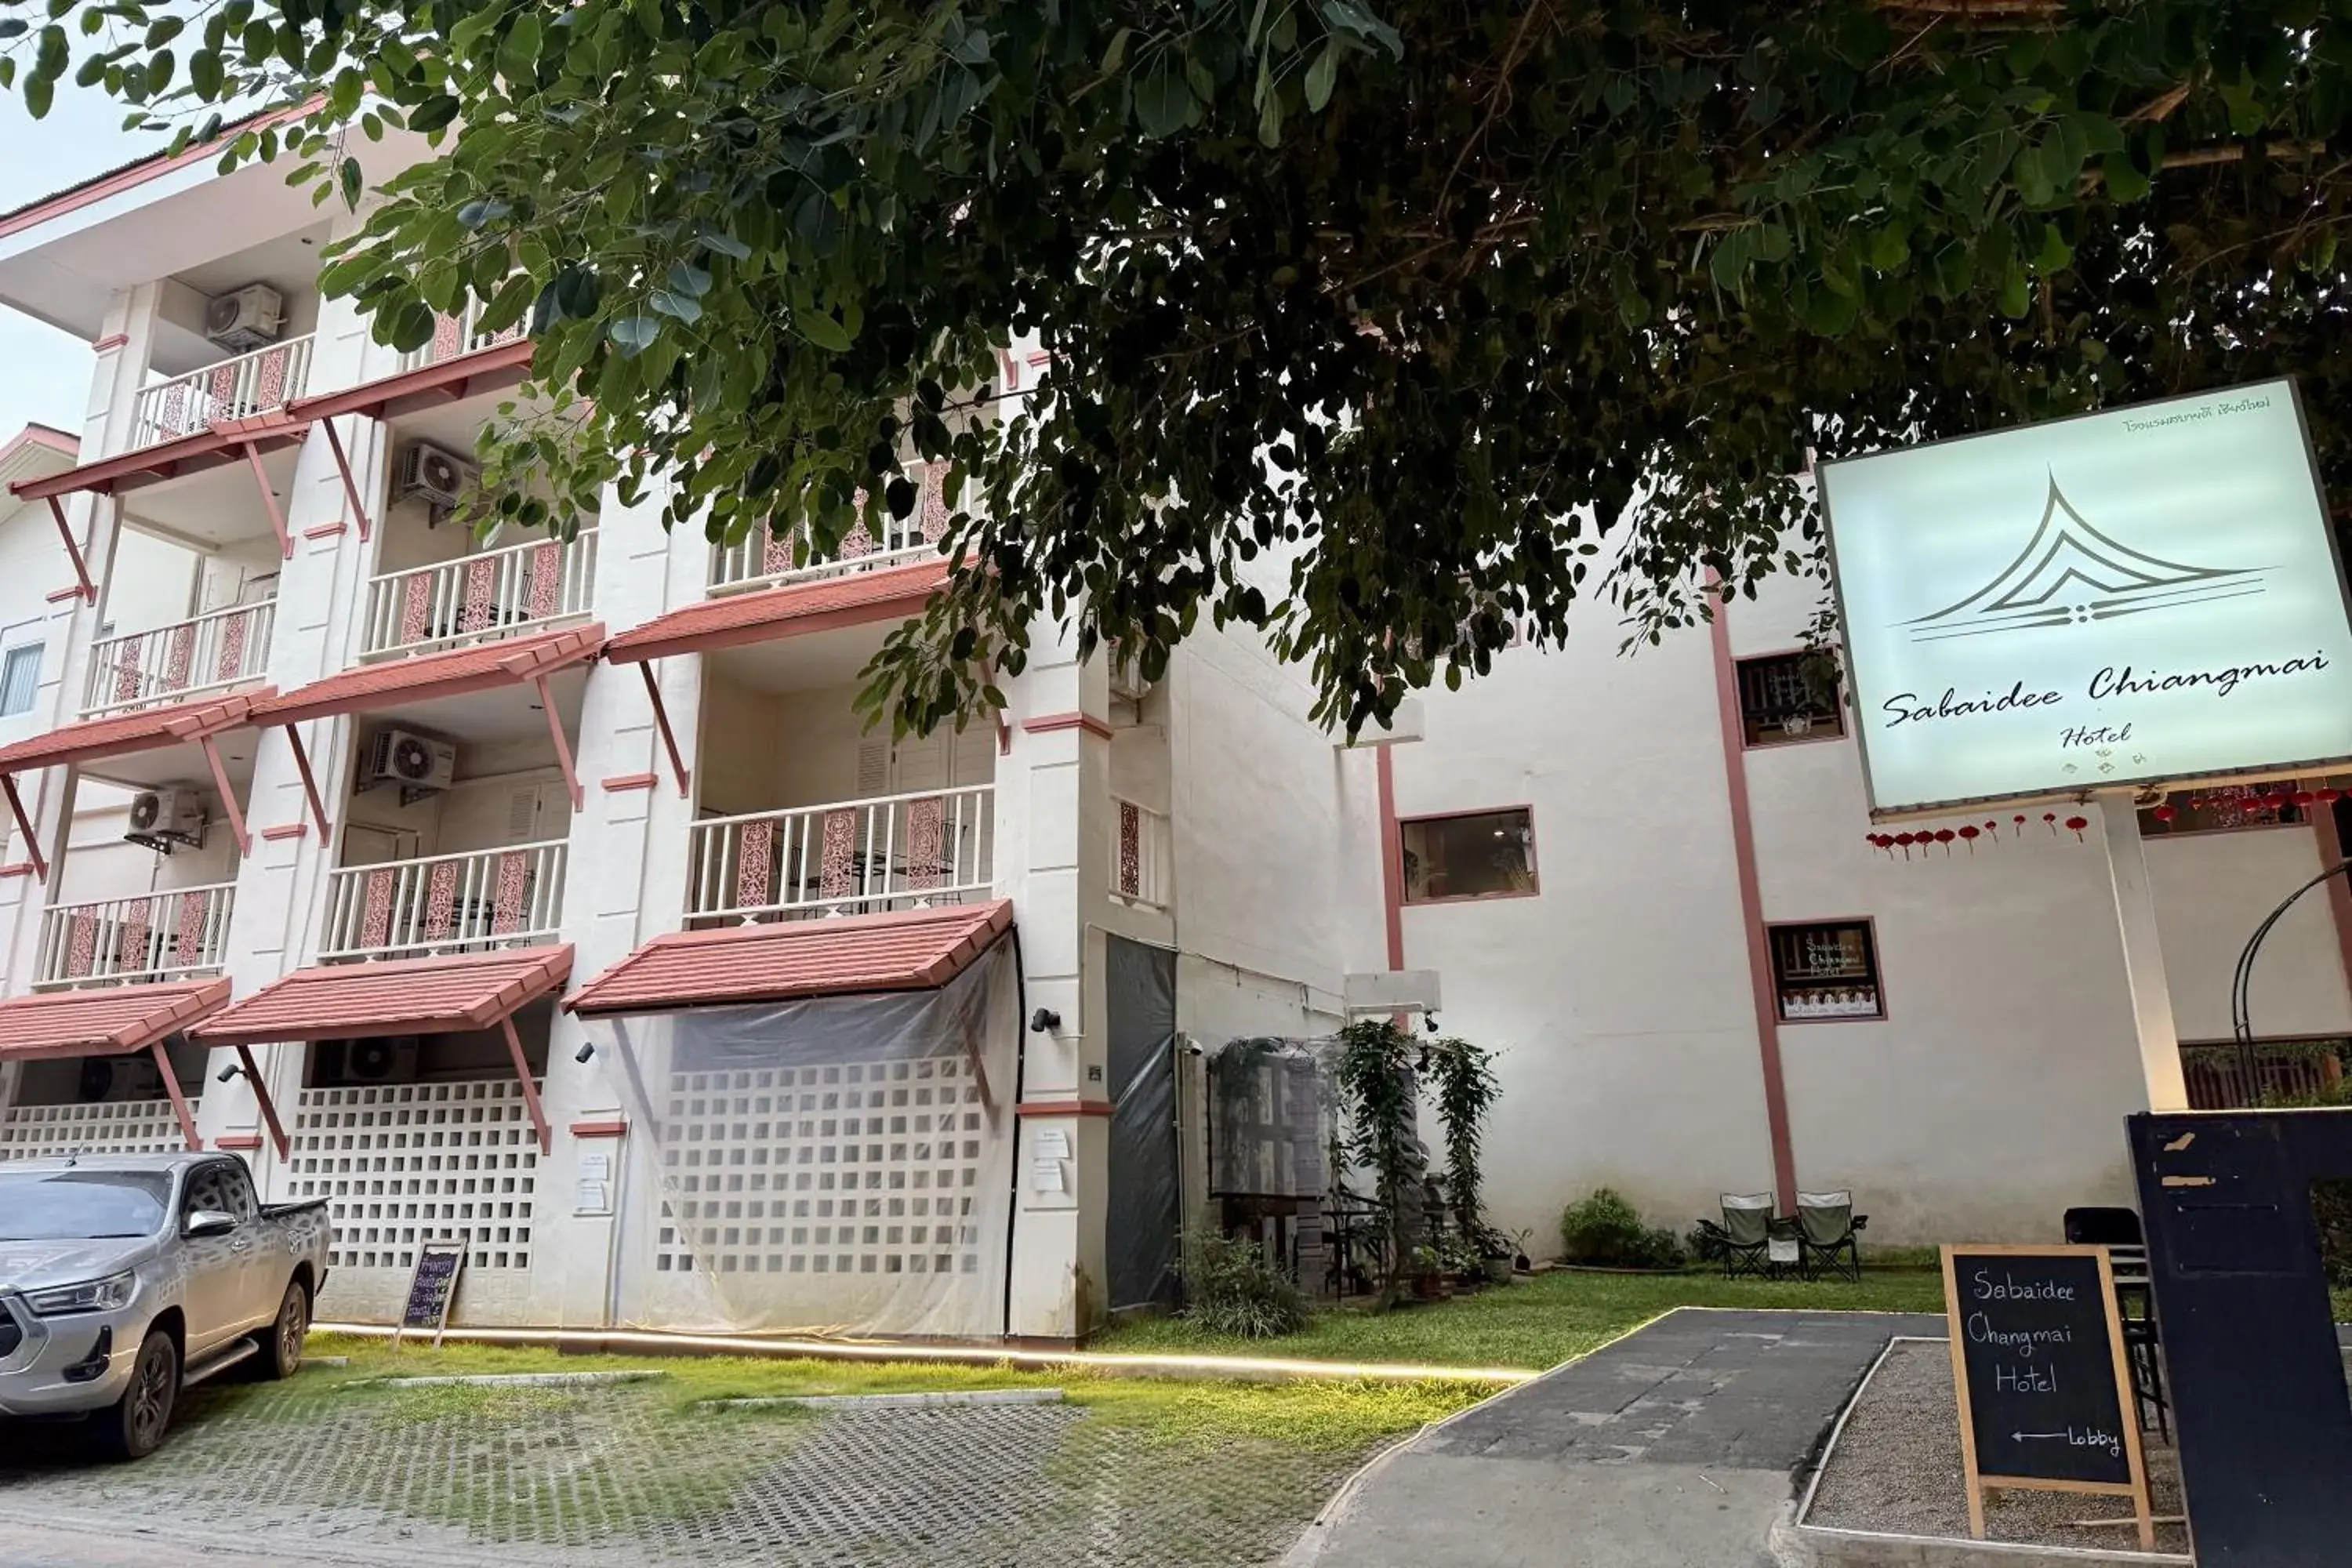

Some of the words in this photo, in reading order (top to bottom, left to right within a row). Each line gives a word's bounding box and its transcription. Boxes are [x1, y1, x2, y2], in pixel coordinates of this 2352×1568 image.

[1883, 681, 2063, 728] Sabaidee
[2089, 649, 2329, 700] Chiangmai
[2060, 722, 2132, 749] Hotel
[1973, 1268, 2075, 1301] Sabaidee
[1968, 1310, 2072, 1357] Changmai
[1995, 1364, 2057, 1392] Hotel
